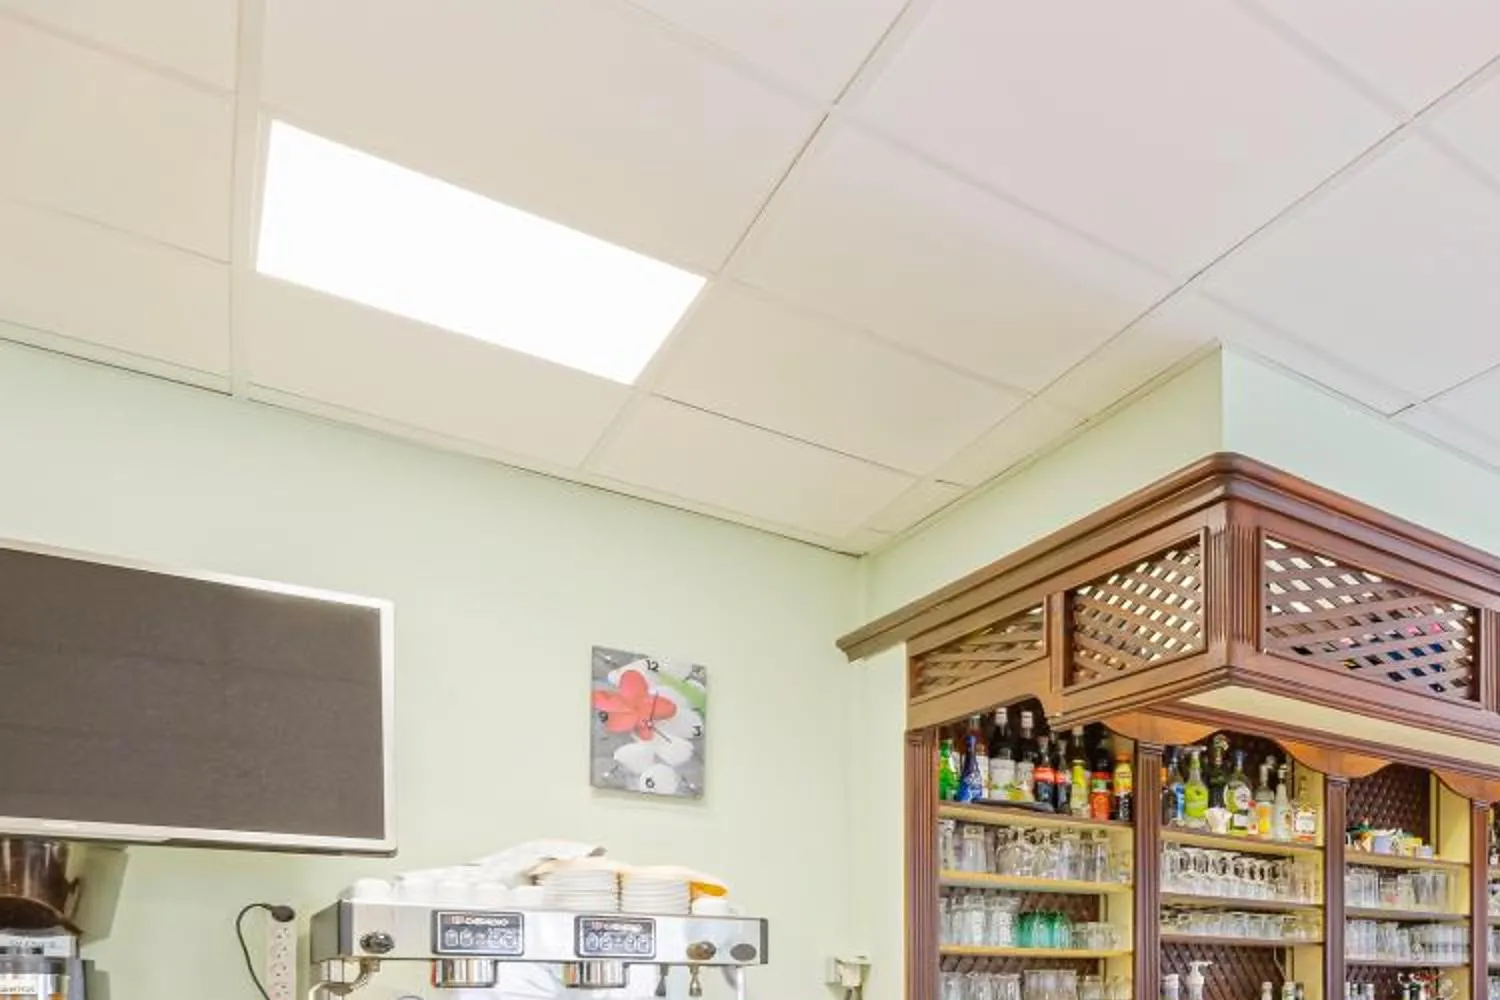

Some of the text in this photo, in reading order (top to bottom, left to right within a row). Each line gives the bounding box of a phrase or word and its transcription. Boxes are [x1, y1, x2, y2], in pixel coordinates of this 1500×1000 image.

[646, 660, 659, 672] 12
[599, 711, 608, 722] 9
[692, 726, 702, 736] 3
[646, 778, 655, 788] 6
